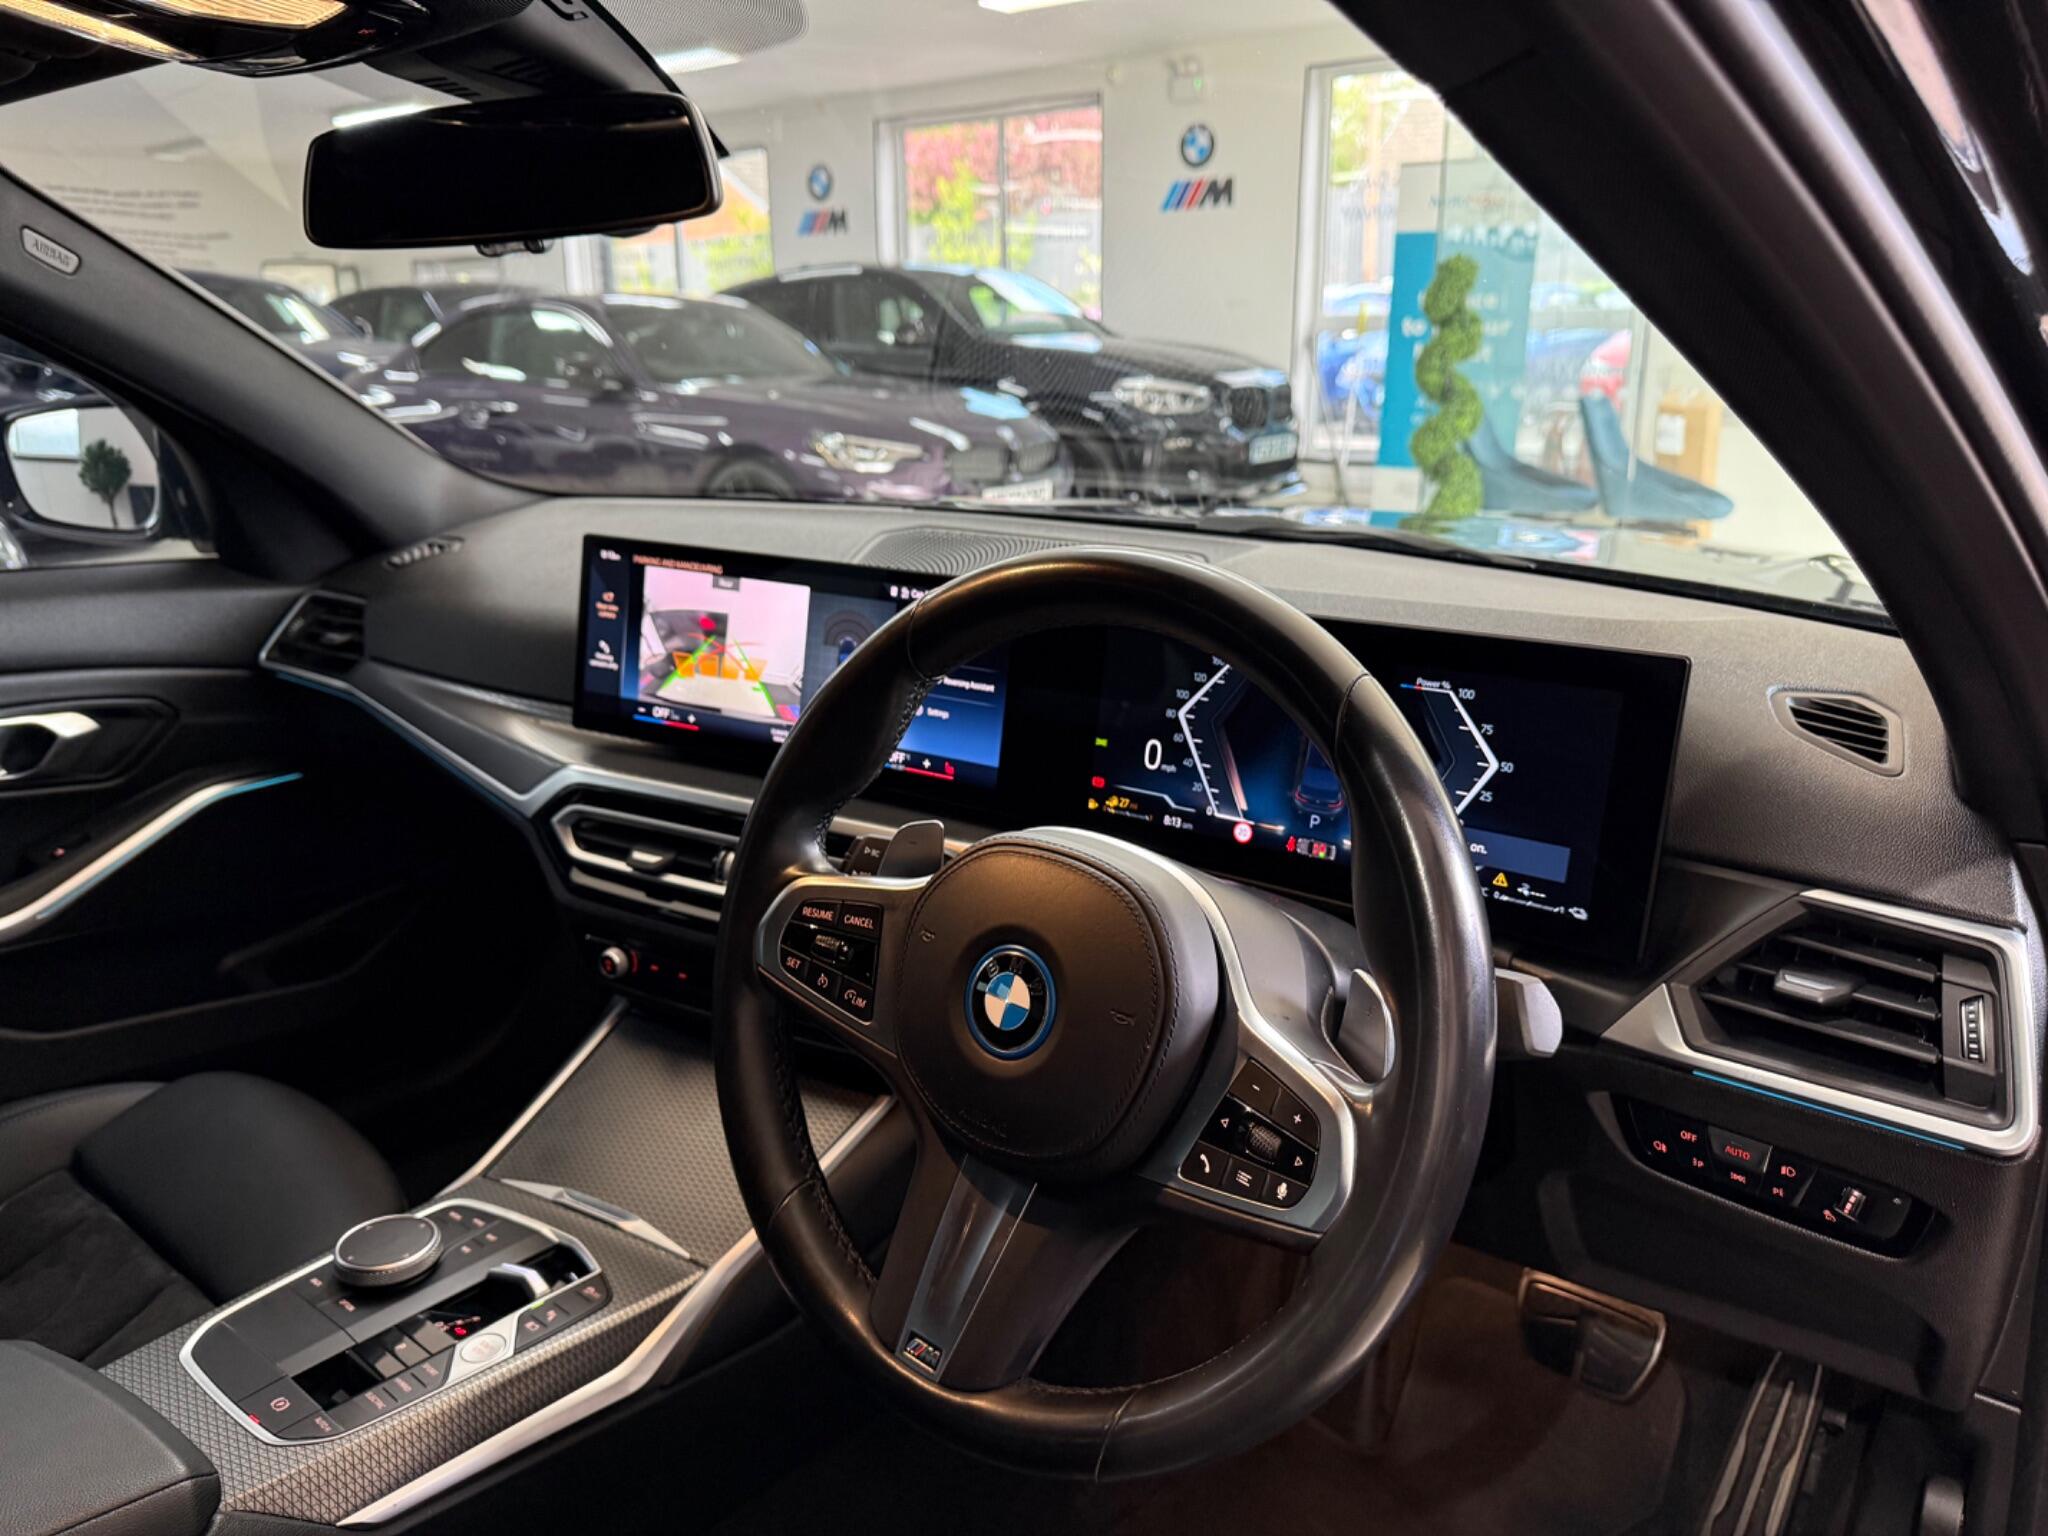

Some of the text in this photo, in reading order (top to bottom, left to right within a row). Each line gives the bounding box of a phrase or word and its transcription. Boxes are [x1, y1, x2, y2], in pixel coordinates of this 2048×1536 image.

[1194, 672, 1207, 682] 120
[1416, 677, 1440, 688] Power
[1176, 689, 1190, 699] 100
[1458, 688, 1476, 700] 100
[1165, 708, 1177, 719] 80
[1481, 723, 1494, 735] 75
[1173, 733, 1184, 743] 60
[1144, 738, 1177, 773] 0 mph
[1182, 758, 1194, 768] 40
[1500, 762, 1514, 773] 50
[1191, 782, 1203, 792] 20
[1480, 791, 1493, 802] 25
[1206, 806, 1213, 816] 0
[1163, 815, 1182, 828] 8:13
[1310, 814, 1321, 829] P
[802, 906, 834, 921] RESUME
[844, 914, 874, 930] CANCEL
[786, 956, 801, 969] SET
[1680, 1130, 1697, 1143] OFF
[1724, 1144, 1751, 1161] AUTO
